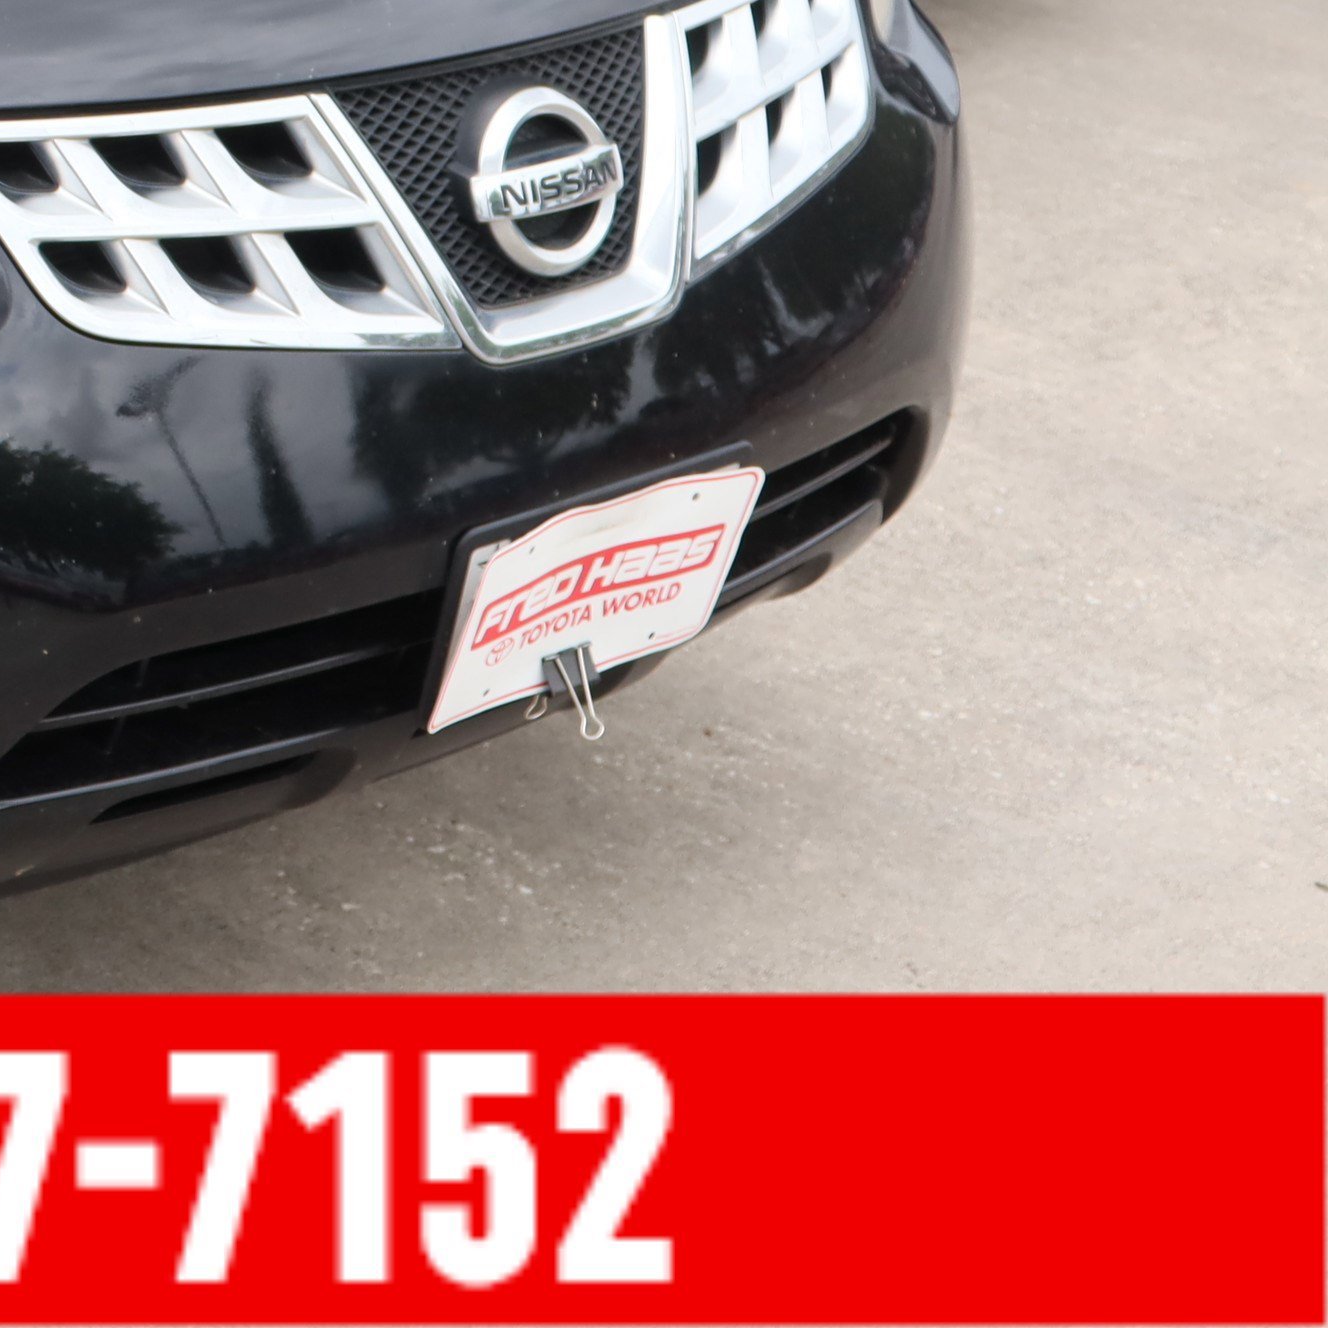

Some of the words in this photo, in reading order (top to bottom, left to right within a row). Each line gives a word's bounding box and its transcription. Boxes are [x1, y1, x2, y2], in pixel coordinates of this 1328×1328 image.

[500, 156, 618, 209] NISSAN
[519, 605, 592, 650] TOYOTA
[602, 582, 682, 617] WORLD
